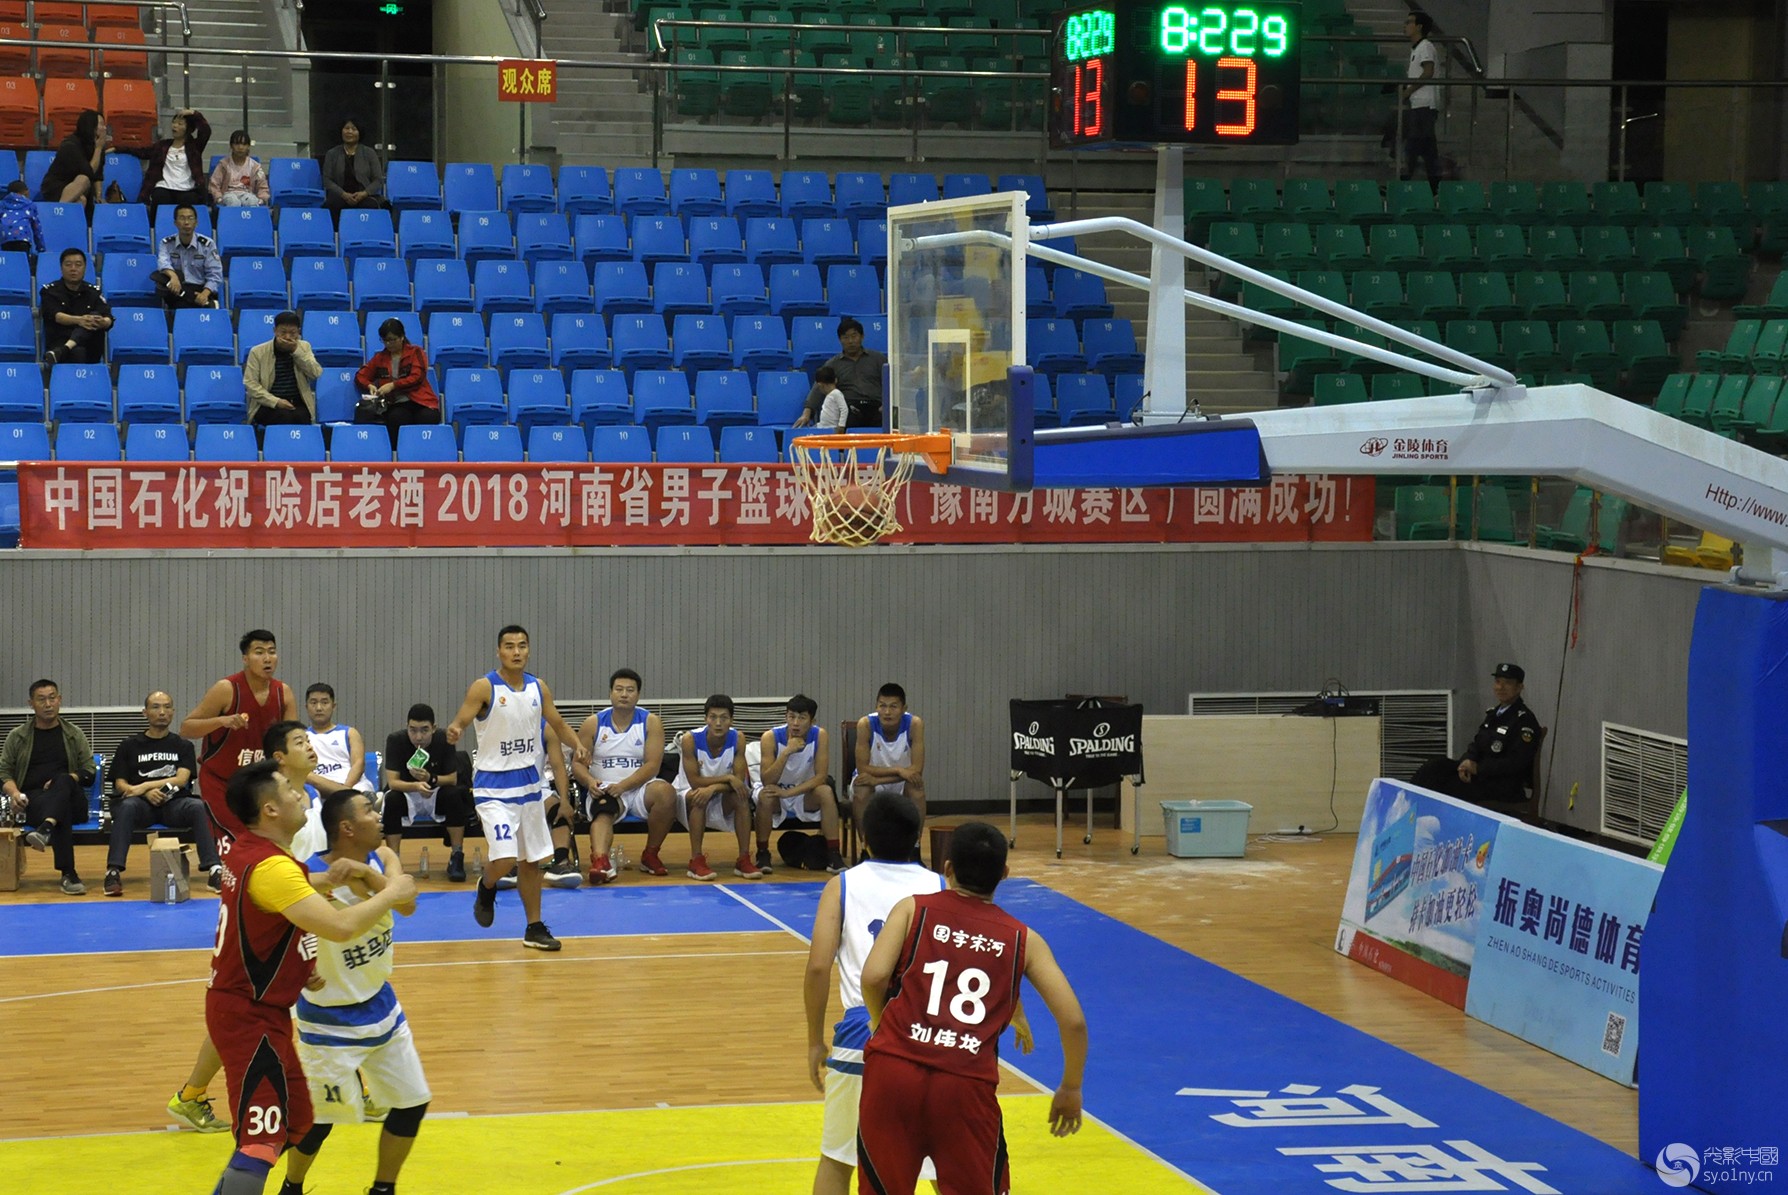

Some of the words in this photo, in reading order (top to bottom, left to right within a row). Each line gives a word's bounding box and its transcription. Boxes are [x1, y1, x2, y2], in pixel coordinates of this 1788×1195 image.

[60, 29, 69, 37] 02
[1161, 7, 1287, 56] 8:229
[688, 53, 696, 61] 01
[6, 81, 15, 89] 03
[502, 67, 552, 95] 观众席
[1073, 58, 1102, 136] 13
[1185, 57, 1257, 135] 13
[109, 157, 118, 165] 03
[635, 172, 642, 180] 12
[54, 207, 64, 215] 02
[117, 209, 127, 217] 03
[241, 211, 251, 219] 05
[302, 212, 311, 220] 06
[360, 213, 369, 221] 07
[479, 217, 488, 225] 09
[540, 218, 547, 226] 10
[656, 221, 663, 229] 12
[710, 222, 718, 230] 13
[824, 223, 831, 231] 15
[1230, 227, 1238, 235] 20
[127, 259, 136, 267] 03
[253, 261, 262, 270] 05
[314, 262, 324, 270] 06
[377, 262, 386, 270] 07
[437, 264, 446, 272] 08
[498, 265, 507, 273] 09
[559, 266, 567, 274] 10
[676, 267, 683, 275] 12
[733, 268, 740, 277] 13
[849, 269, 856, 277] 15
[1, 311, 10, 319] 01
[133, 313, 143, 321] 03
[200, 314, 210, 322] 04
[264, 315, 274, 324] 05
[329, 316, 338, 324] 06
[452, 317, 462, 326] 08
[514, 318, 524, 326] 09
[576, 319, 584, 327] 10
[636, 320, 643, 328] 11
[697, 320, 704, 329] 12
[754, 321, 762, 330] 13
[873, 322, 881, 331] 15
[1105, 323, 1112, 331] 19
[7, 368, 16, 377] 01
[76, 369, 86, 378] 02
[144, 370, 154, 379] 03
[210, 370, 221, 379] 04
[340, 373, 350, 381] 06
[471, 374, 480, 382] 08
[533, 374, 543, 383] 09
[596, 375, 604, 383] 10
[658, 376, 665, 384] 11
[720, 376, 727, 384] 12
[780, 376, 788, 384] 13
[1336, 378, 1345, 386] 20
[1392, 379, 1400, 387] 21
[13, 429, 22, 438] 01
[84, 430, 95, 439] 02
[155, 430, 166, 439] 03
[223, 430, 233, 439] 04
[290, 430, 301, 439] 05
[358, 431, 368, 439] 06
[422, 430, 432, 439] 07
[489, 431, 499, 440] 08
[553, 432, 562, 441] 09
[619, 431, 628, 440] 10
[683, 432, 689, 440] 11
[745, 432, 753, 440] 12
[1393, 438, 1449, 453] 金陵体育
[1415, 492, 1424, 501] 20
[1013, 731, 1055, 755] SPALDING
[1069, 734, 1135, 756] SPALDING
[138, 752, 179, 763] IMPERIUM
[495, 824, 512, 841] 12
[1493, 876, 1644, 975] 振奥尚德体育
[1487, 935, 1509, 953] ZHEN
[1510, 945, 1522, 957] AO
[1522, 947, 1548, 969] SHANG
[1548, 958, 1560, 973] DE
[1560, 962, 1591, 986] SPORTS
[1591, 976, 1636, 1005] ACTIVITIES
[923, 959, 990, 1025] 18
[908, 1022, 982, 1055] 刘伟龙
[247, 1105, 282, 1135] 30
